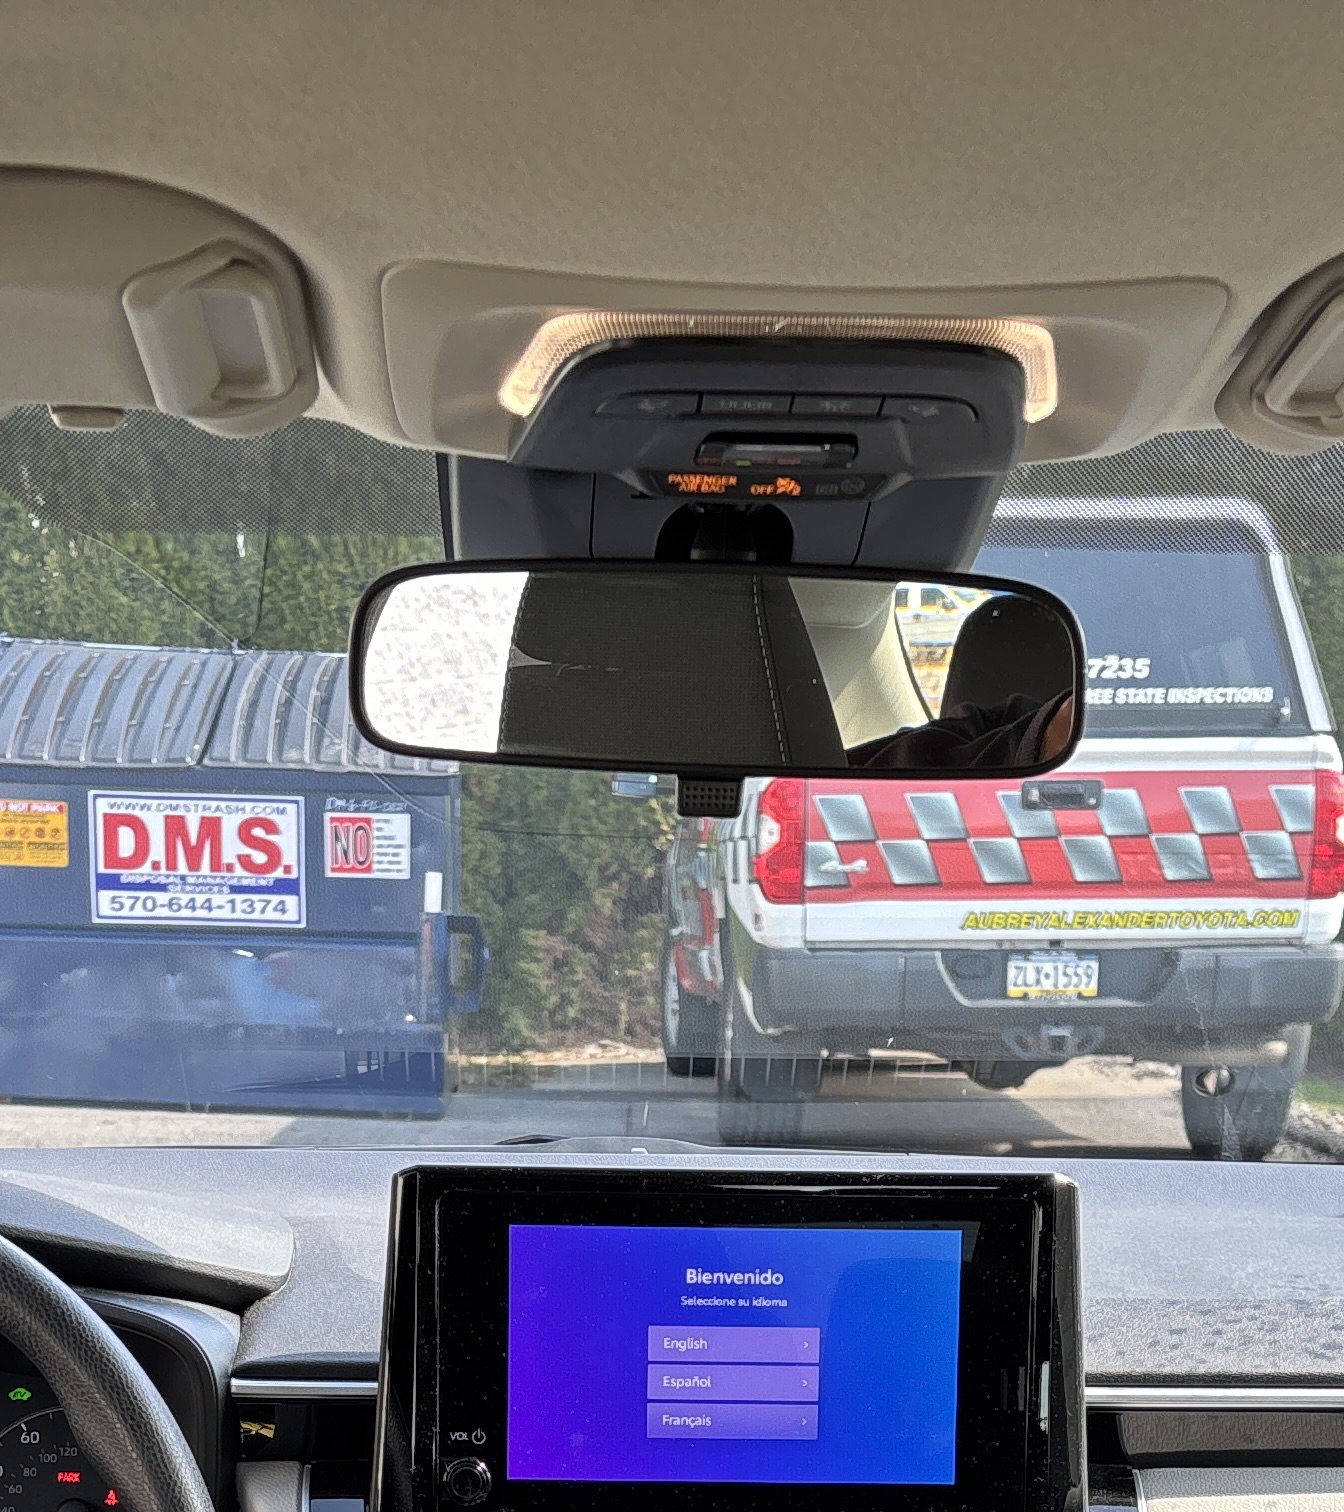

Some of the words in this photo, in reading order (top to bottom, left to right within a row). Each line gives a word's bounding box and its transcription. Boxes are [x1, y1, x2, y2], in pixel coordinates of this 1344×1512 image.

[668, 474, 737, 486] PASSENGER
[678, 484, 697, 493] AIR
[701, 484, 725, 494] BAG
[751, 484, 774, 495] OFF
[1086, 654, 1150, 679] 7235
[1116, 687, 1167, 704] STATE
[1167, 686, 1274, 703] INSPECTIONS
[107, 801, 288, 816] WWW.DMSTRASH.COM
[102, 813, 293, 875] D.M.S.
[330, 821, 371, 869] NO
[119, 873, 181, 884] DISPOSAL
[185, 875, 274, 887] MANAGEMENT
[166, 884, 231, 894] SERVICES
[109, 895, 289, 915] 570-644-1374
[959, 909, 1300, 930] AUBREYALEXANDERTOYOTA.COM
[686, 1268, 784, 1285] Bienvenido
[680, 1295, 736, 1307] Seleccione
[738, 1298, 750, 1307] su
[752, 1296, 788, 1307] idioma
[663, 1337, 708, 1352] English
[662, 1375, 712, 1390] Español
[662, 1414, 712, 1429] Français
[21, 1432, 40, 1444] 60
[449, 1431, 469, 1441] VOL
[39, 1453, 57, 1463] 100
[59, 1447, 78, 1457] 120
[23, 1467, 37, 1477] 80
[57, 1472, 81, 1483] PARK
[9, 1485, 23, 1494] 60
